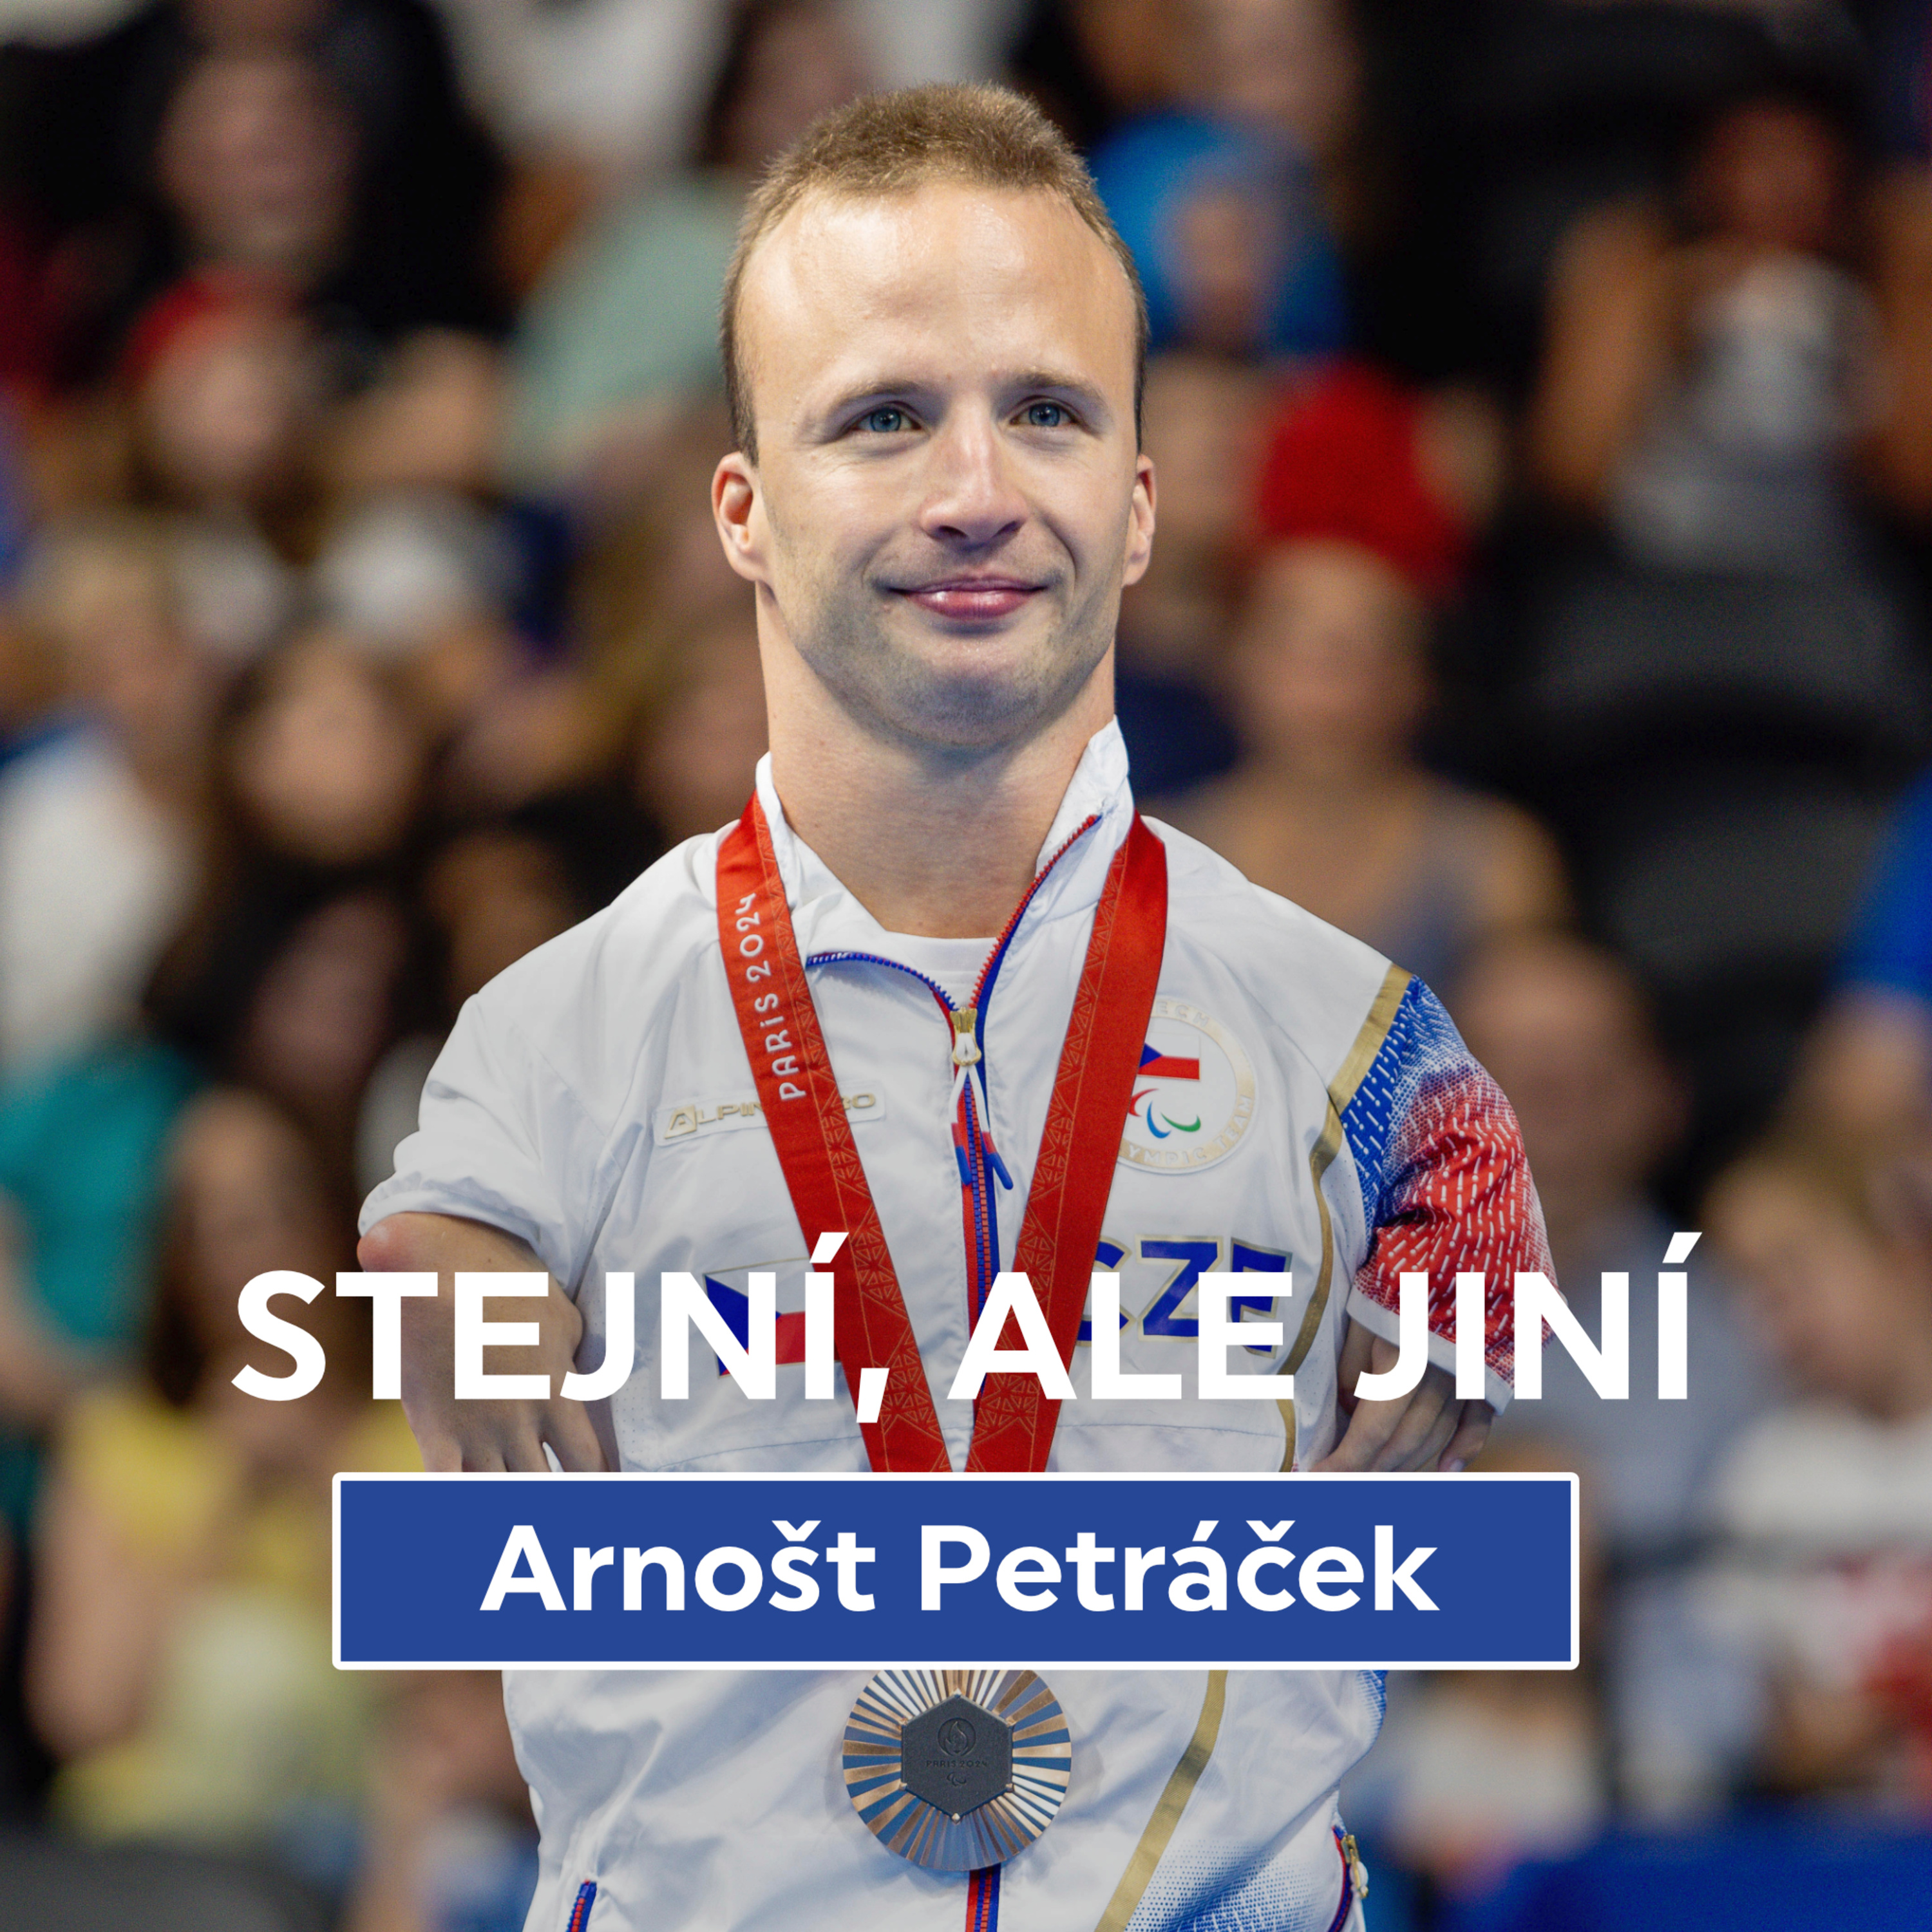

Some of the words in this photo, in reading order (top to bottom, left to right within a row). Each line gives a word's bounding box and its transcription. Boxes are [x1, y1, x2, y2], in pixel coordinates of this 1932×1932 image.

[735, 893, 772, 982] 2024
[1157, 1000, 1209, 1028] ECH
[665, 1101, 762, 1139] ALPIN
